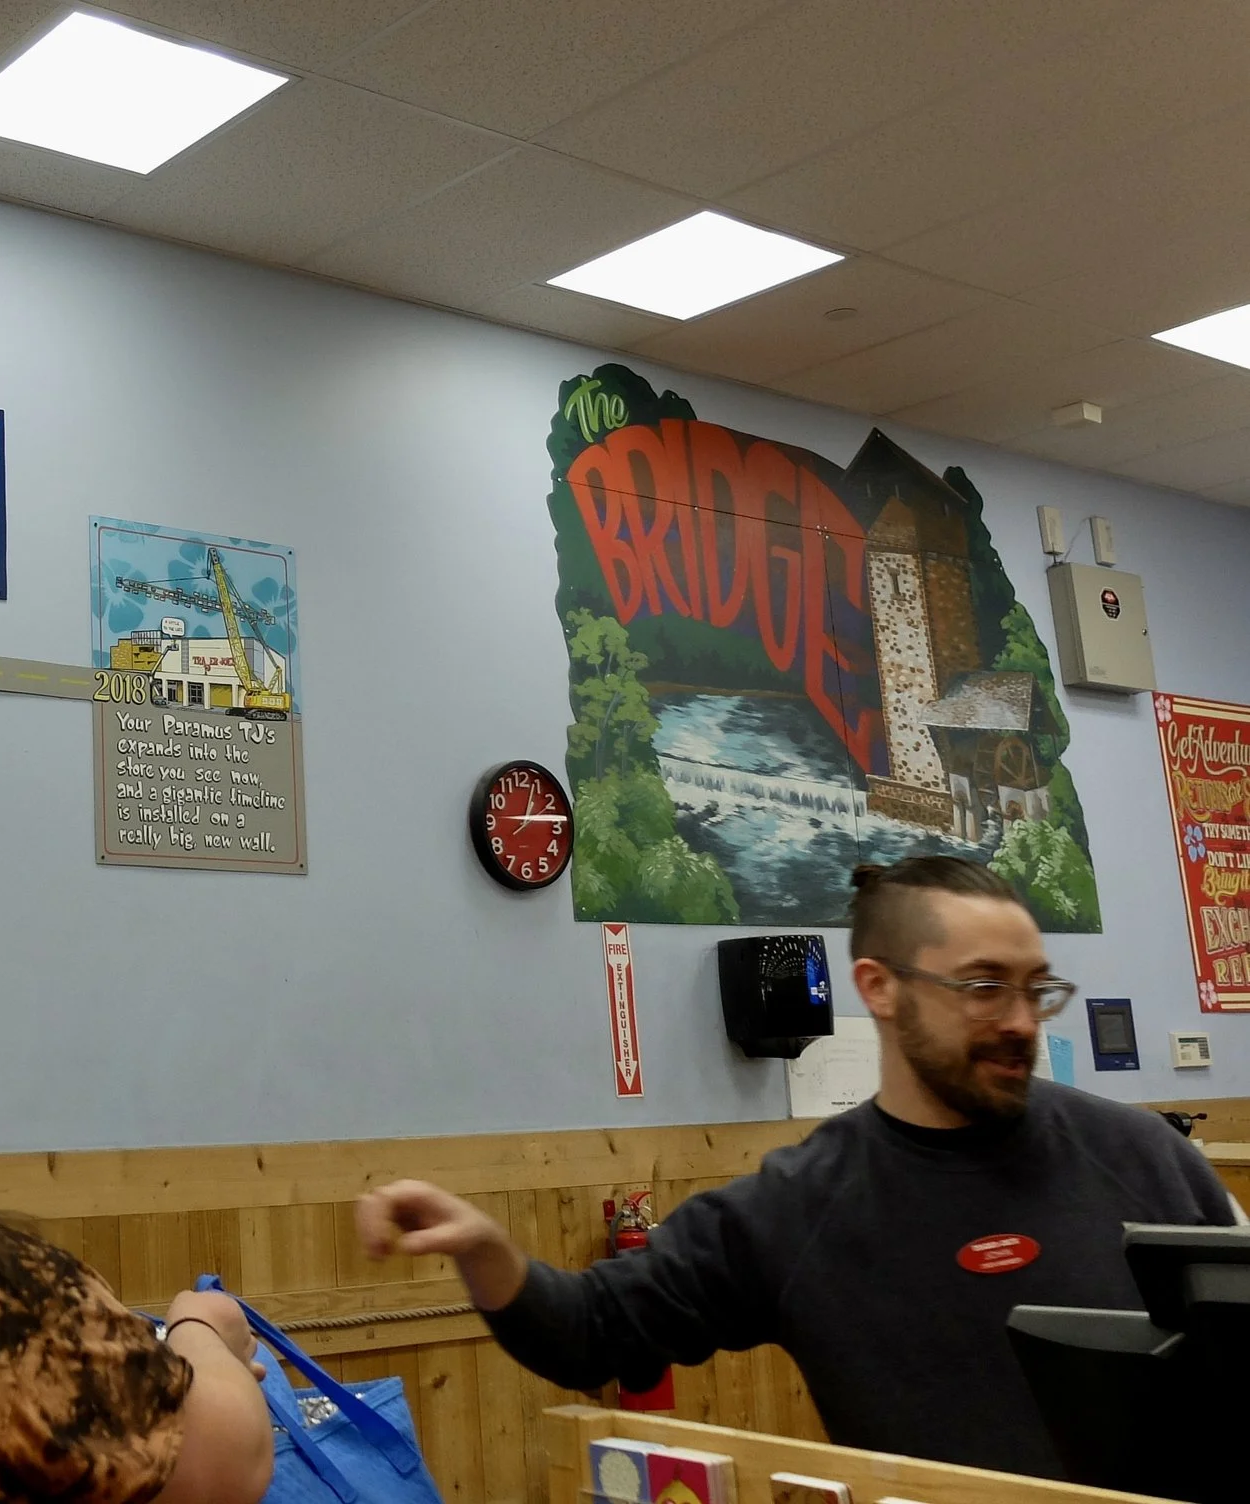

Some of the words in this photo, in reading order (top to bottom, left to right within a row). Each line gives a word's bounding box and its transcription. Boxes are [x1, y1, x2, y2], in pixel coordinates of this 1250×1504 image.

[565, 378, 630, 443] The
[566, 418, 872, 777] BRIDGE
[94, 671, 146, 704] 2018
[116, 711, 152, 731] Your
[163, 714, 233, 739] Paramus
[239, 721, 276, 744] TJ's
[118, 738, 182, 758] expands
[189, 742, 217, 760] into
[225, 744, 249, 763] the
[117, 756, 154, 777] store
[159, 766, 185, 780] you
[195, 768, 222, 782] see
[231, 770, 263, 787] now,
[512, 772, 529, 788] 12
[499, 778, 512, 793] 11
[534, 779, 540, 794] 1
[117, 781, 143, 799] and
[149, 787, 157, 800] a
[162, 785, 222, 806] gigantic
[230, 787, 285, 809] timeline
[490, 794, 505, 810] 10
[545, 794, 555, 810] 2
[118, 803, 130, 820] is
[139, 804, 200, 823] installed
[211, 812, 229, 825] on
[236, 813, 245, 827] a
[486, 814, 495, 830] 9
[118, 825, 162, 850] really
[169, 825, 197, 850] big,
[205, 834, 231, 847] new
[240, 832, 275, 851] wall.
[492, 837, 503, 854] 8
[547, 840, 558, 856] 4
[506, 855, 515, 871] 7
[521, 862, 532, 879] 6
[538, 857, 548, 872] 5
[608, 943, 627, 956] FIRE
[616, 963, 632, 1077] EXTINGUISHER
